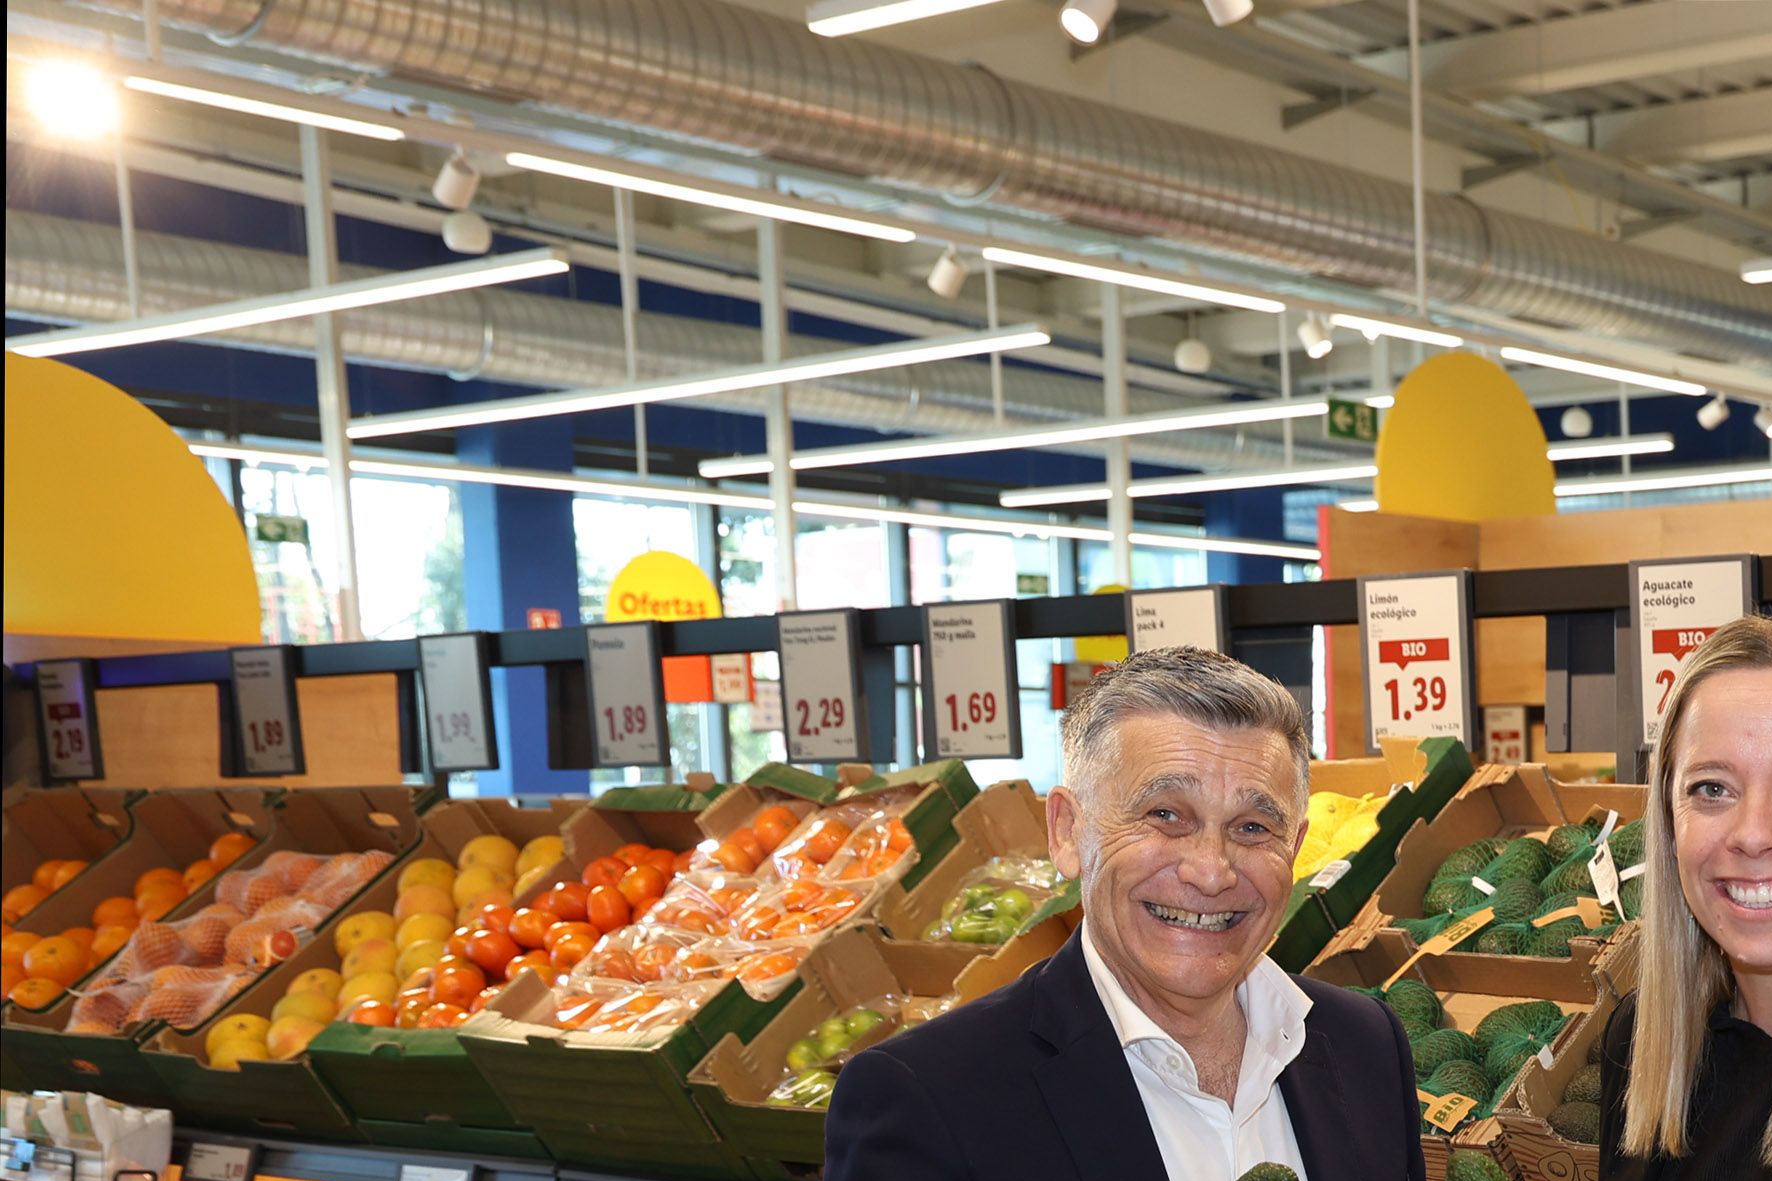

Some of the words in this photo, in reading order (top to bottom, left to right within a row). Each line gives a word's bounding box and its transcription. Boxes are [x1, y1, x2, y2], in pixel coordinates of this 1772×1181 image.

[1643, 580, 1693, 594] Aguacate
[619, 592, 707, 616] Ofertas
[1370, 593, 1399, 605] Limón
[1643, 594, 1696, 608] ecológico
[1135, 607, 1156, 618] Lima
[1370, 607, 1417, 621] ecológico
[933, 617, 973, 628] Mandarina
[1137, 620, 1157, 632] pack
[955, 630, 976, 641] malla
[1677, 631, 1706, 647] BIO
[1401, 642, 1427, 657] BIO
[1384, 676, 1447, 721] 1.39
[797, 697, 846, 736] 2.29
[946, 691, 996, 733] 1.69
[604, 704, 647, 743] 1.89
[1436, 723, 1443, 731] kg
[248, 720, 284, 753] 1.89
